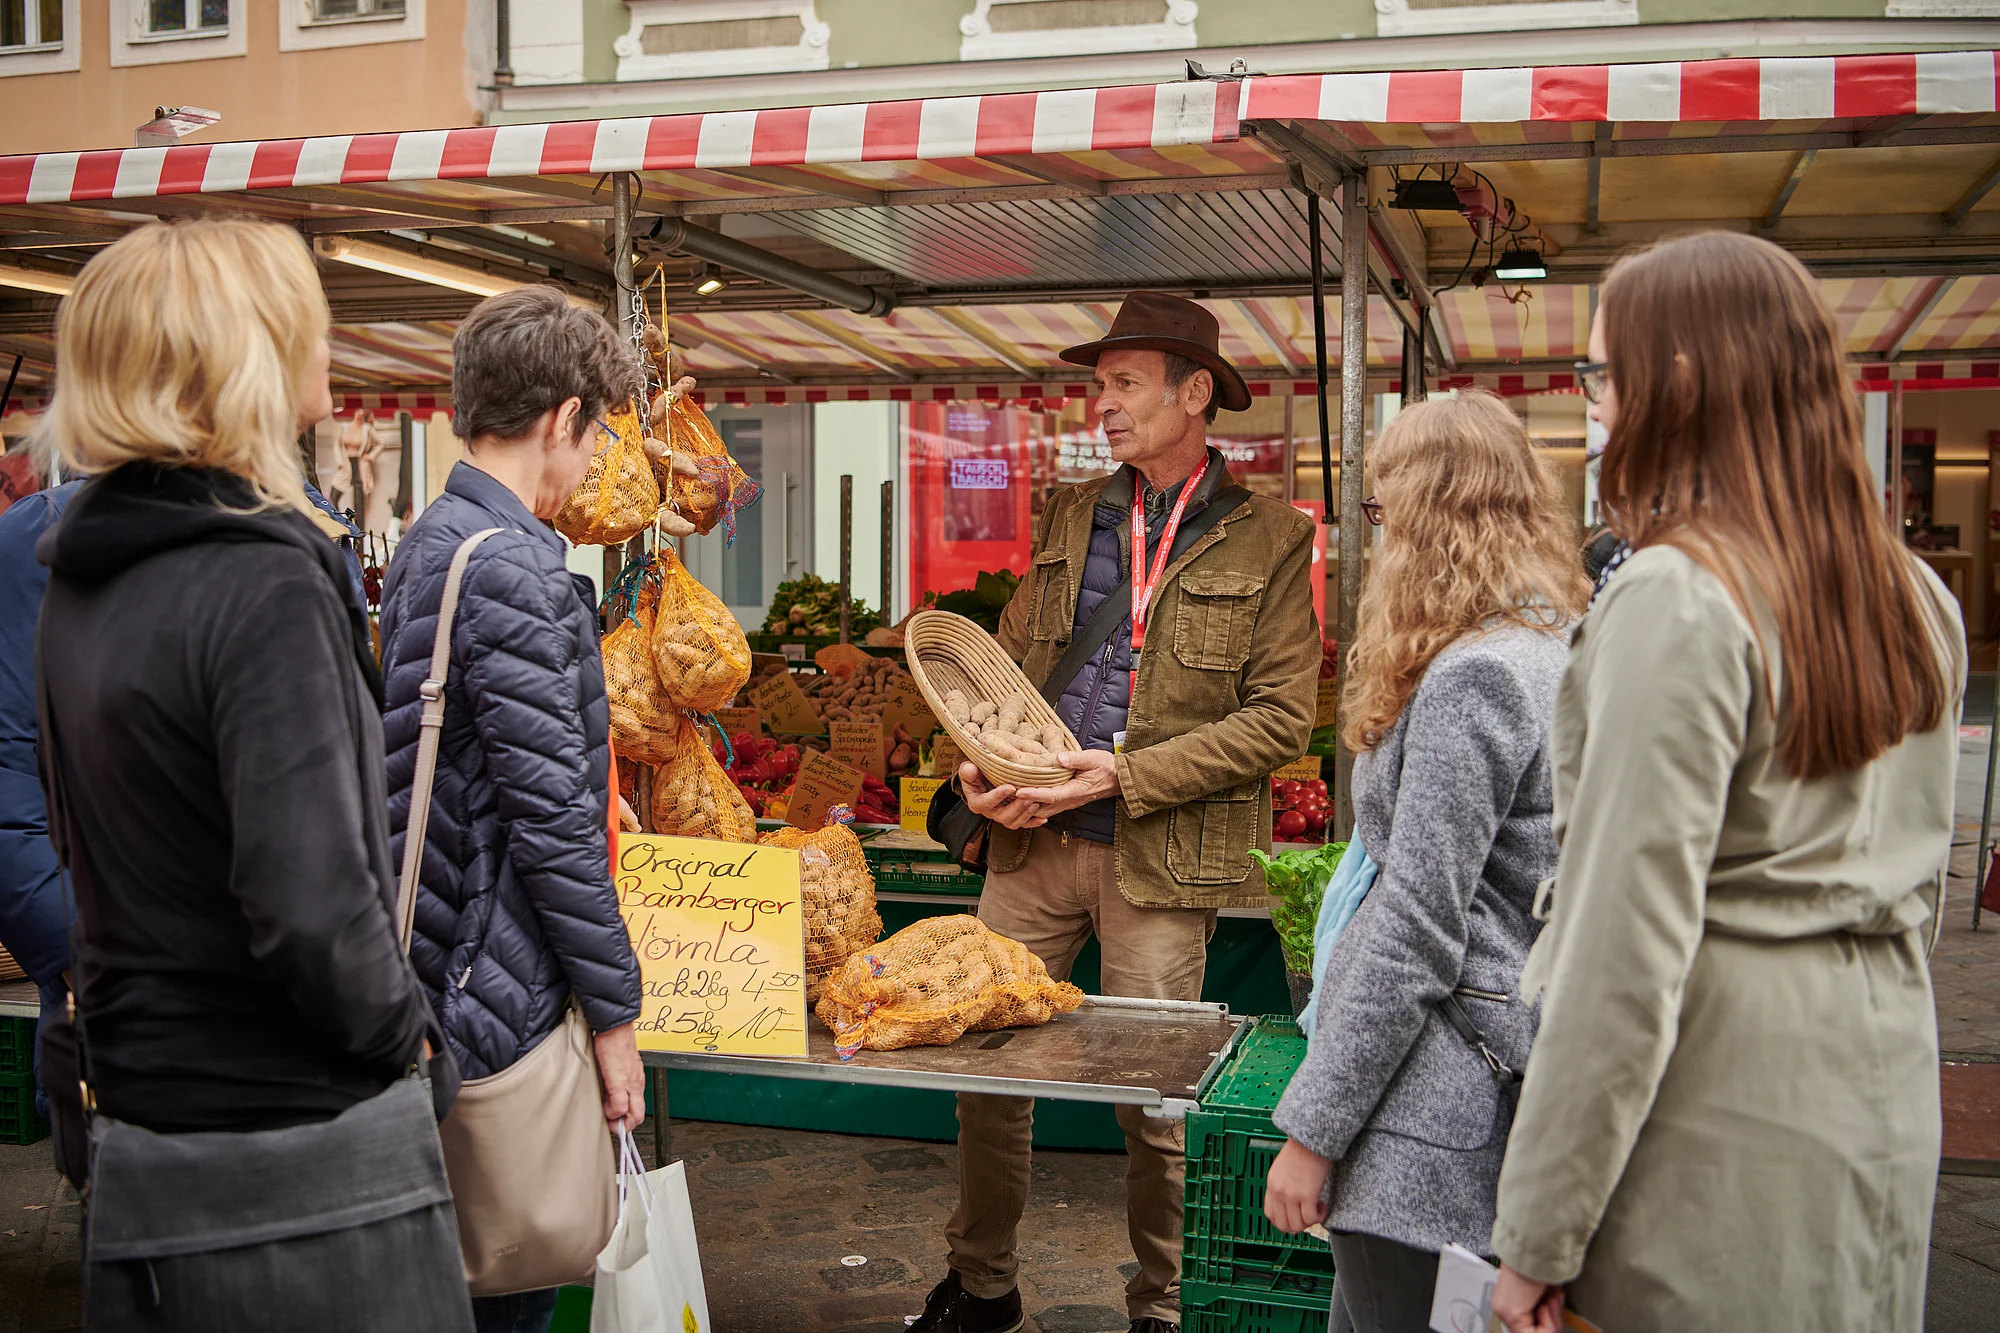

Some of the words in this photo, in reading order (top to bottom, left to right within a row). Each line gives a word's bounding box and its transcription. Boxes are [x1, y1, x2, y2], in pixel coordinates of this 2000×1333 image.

[1134, 539, 1142, 583] www.bamberg.info
[1151, 540, 1170, 583] www.bamberg.info
[620, 842, 758, 891] Orginal
[617, 875, 796, 932] Bamberger
[641, 967, 689, 998] ack
[634, 1004, 670, 1033] ack
